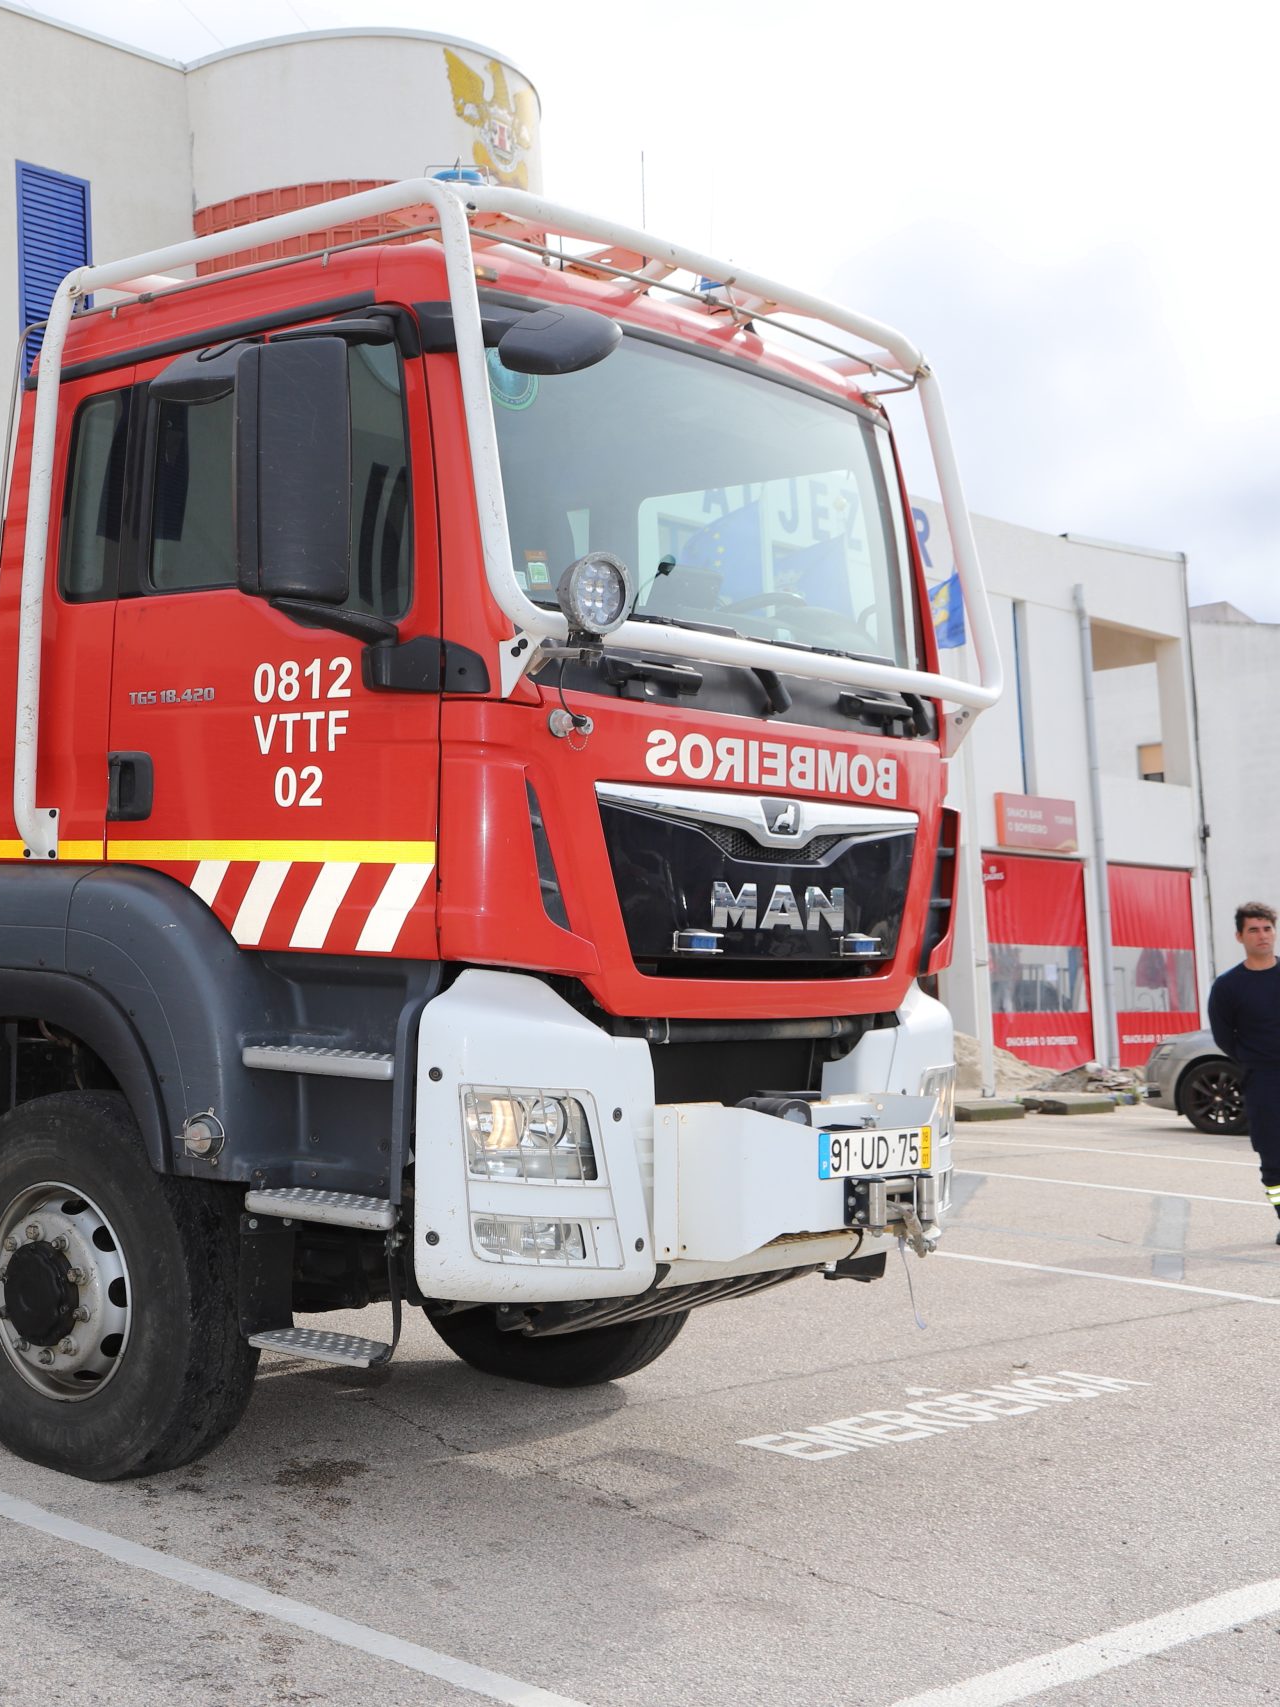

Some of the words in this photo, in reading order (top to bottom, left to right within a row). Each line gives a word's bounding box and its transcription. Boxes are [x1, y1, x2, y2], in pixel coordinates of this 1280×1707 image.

[129, 690, 157, 705] TGS
[159, 687, 216, 704] 18.420
[253, 656, 353, 704] 0812
[253, 709, 350, 755] VTTF
[273, 765, 324, 808] 02
[710, 881, 845, 932] MAN
[735, 1371, 1153, 1461] EMERGÊNCIA
